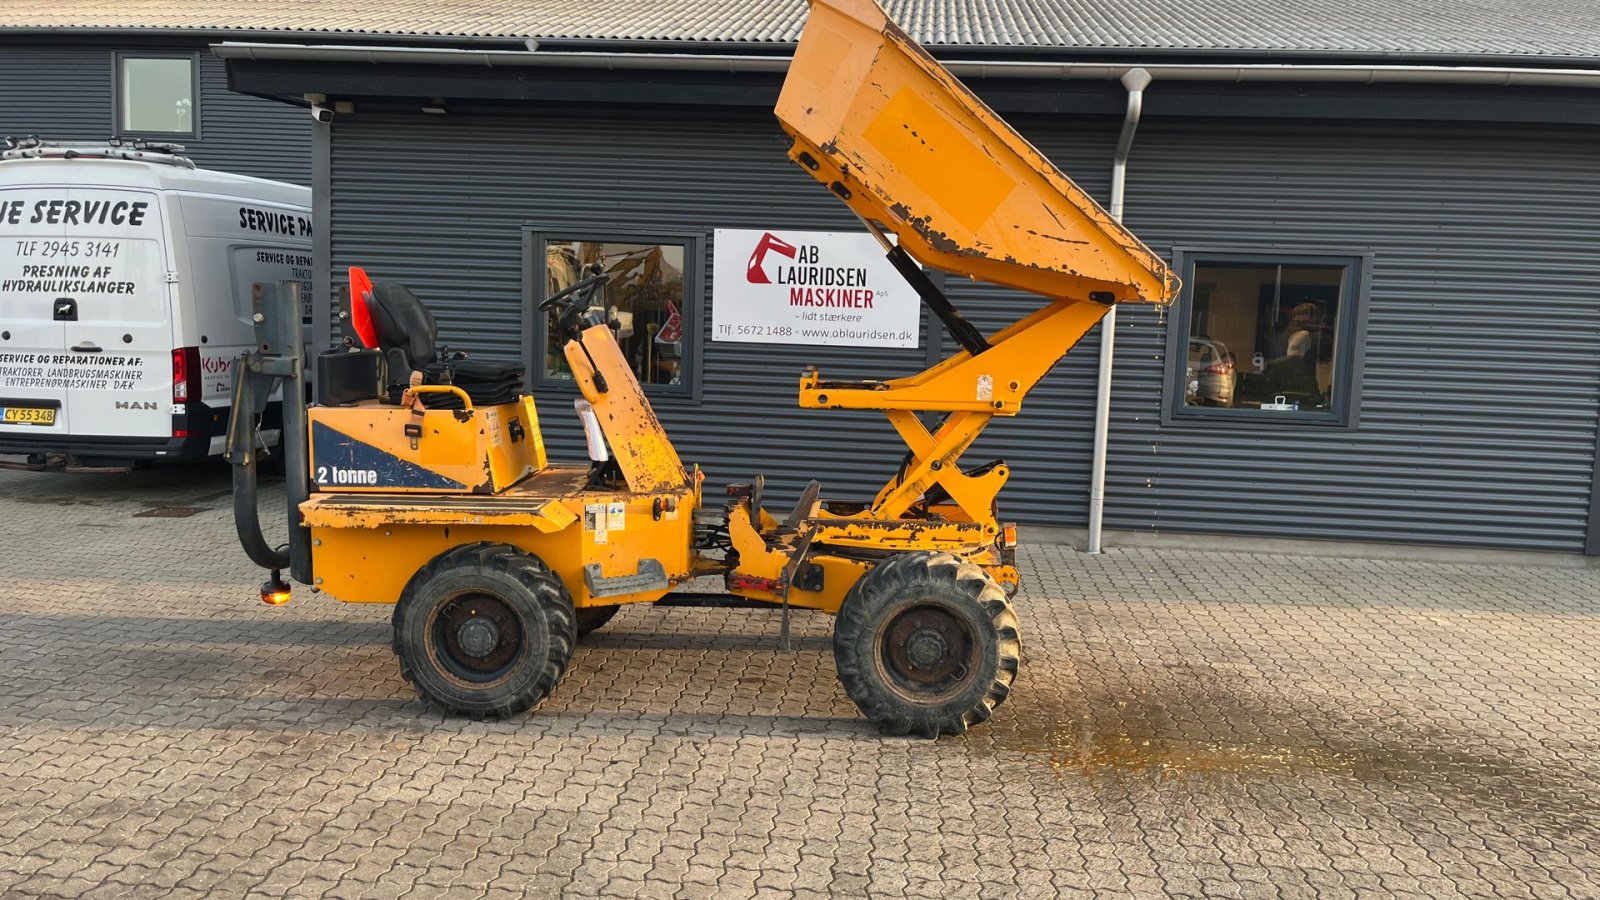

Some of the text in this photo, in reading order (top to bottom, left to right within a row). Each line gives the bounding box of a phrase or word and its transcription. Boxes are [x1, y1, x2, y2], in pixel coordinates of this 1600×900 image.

[30, 200, 149, 226] SERVICE
[239, 207, 296, 236] SERVICE
[16, 241, 120, 258] TLF 2945 3141
[798, 245, 819, 264] AB
[256, 251, 284, 264] SERVICE
[285, 254, 295, 265] OG
[22, 265, 112, 279] PRESNING AF
[777, 266, 866, 287] LAURIDSEN
[2, 280, 136, 295] HYDRAULIKSLANGER
[789, 287, 889, 309] MASKINER ApS
[802, 311, 817, 321] lidt
[819, 312, 862, 323] stærkere
[718, 324, 734, 336] Tlf.
[737, 324, 764, 335] 5672
[766, 326, 793, 336] 1488
[802, 328, 913, 341] www.ablauridsen.dk
[0, 354, 144, 367] SERVICE OG REPARATIONER AF:
[0, 367, 143, 380] TRAKTORER LANDBRUGSMASKINER
[5, 378, 135, 390] ENTREPRENØRMASKINER DÆK
[115, 401, 158, 410] MAN
[5, 409, 53, 421] CY 55 348
[317, 466, 378, 484] 2 tonne
